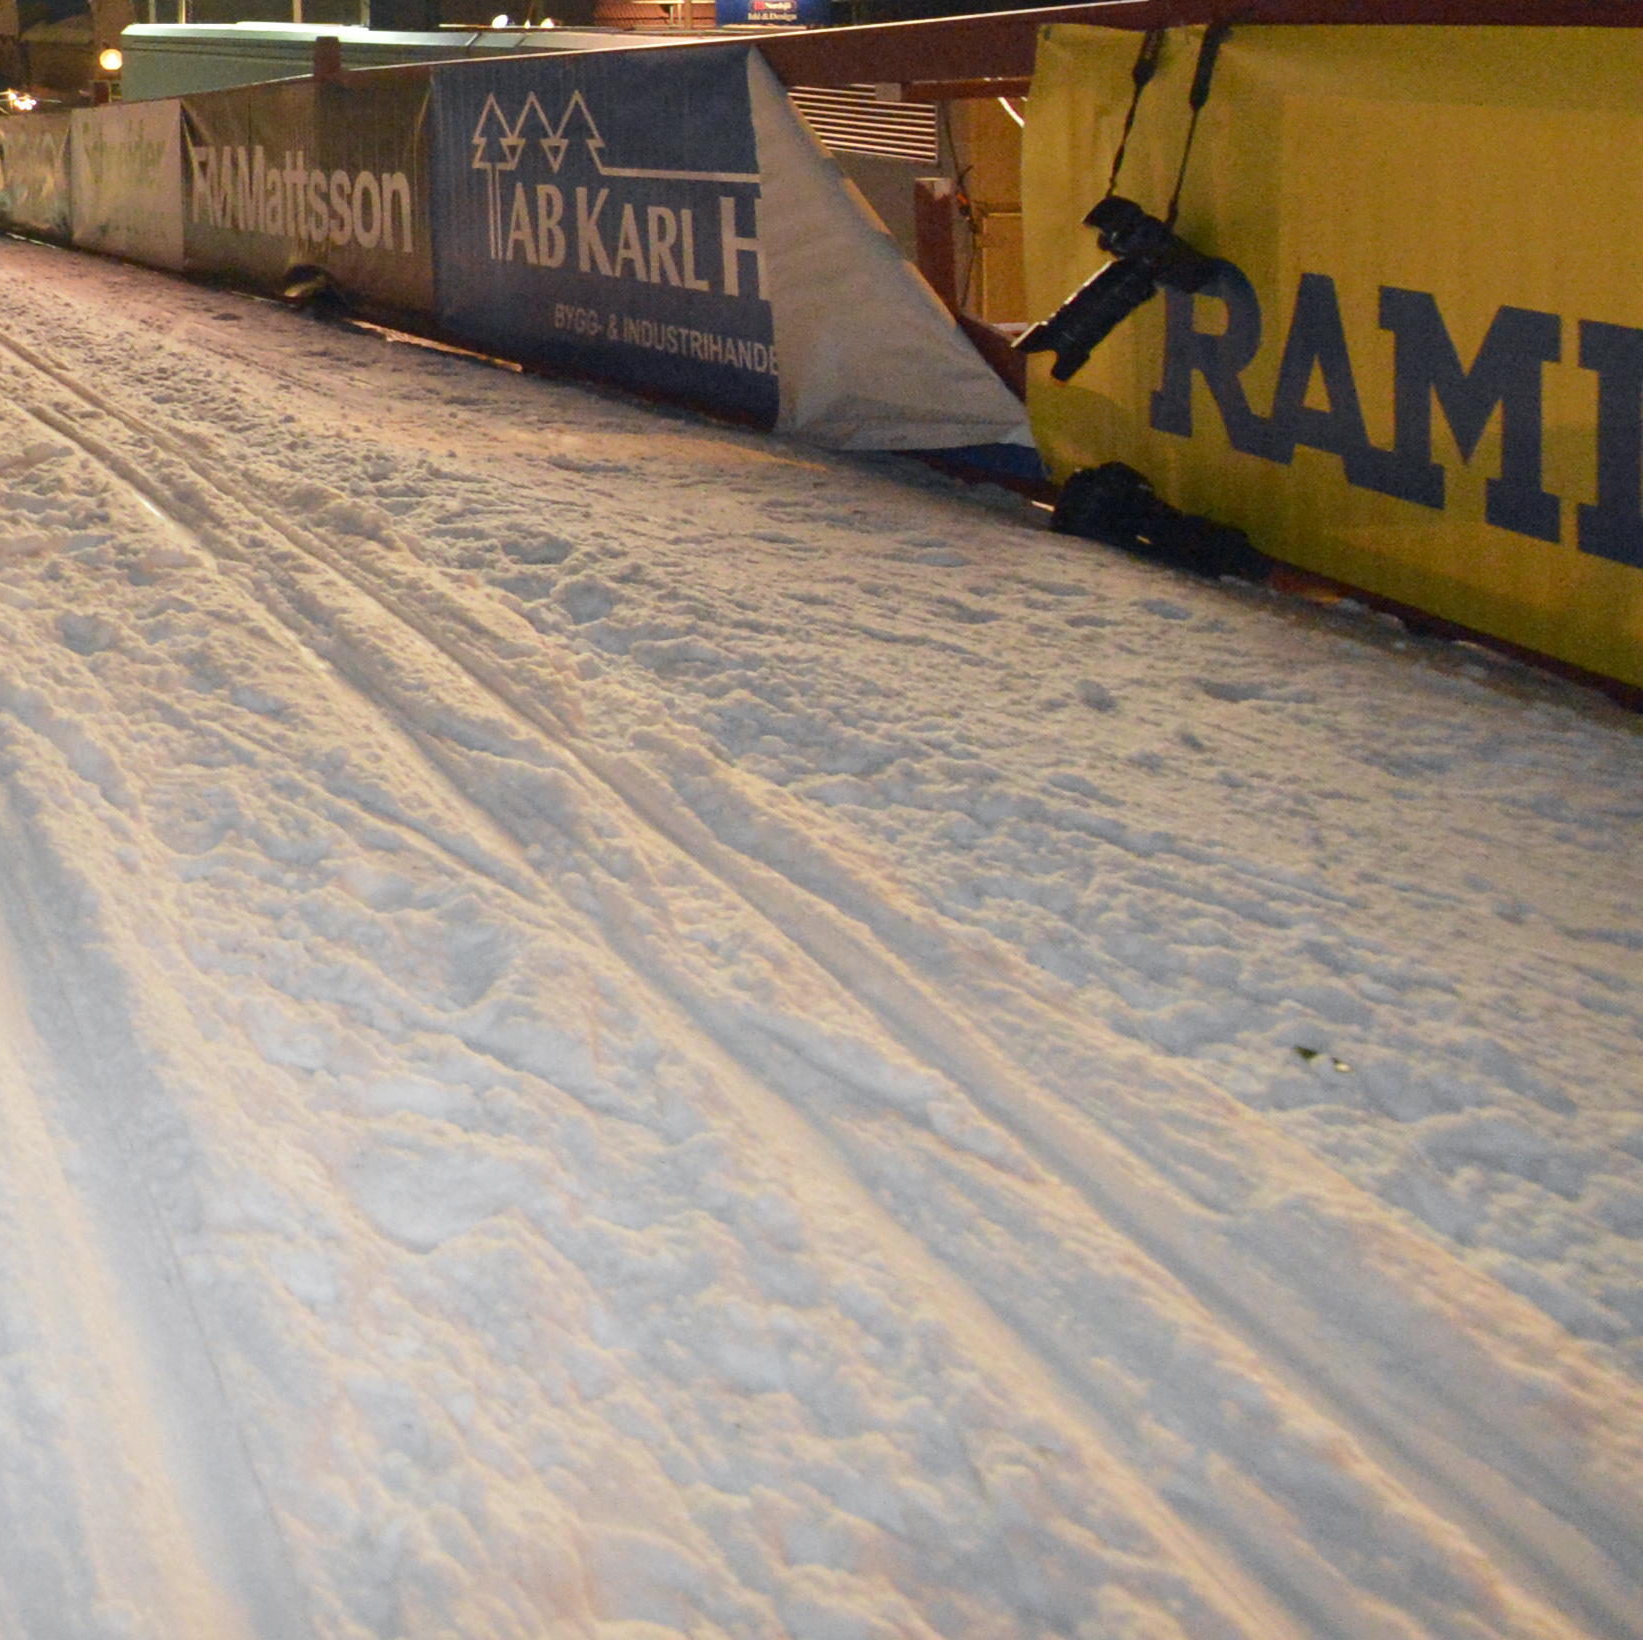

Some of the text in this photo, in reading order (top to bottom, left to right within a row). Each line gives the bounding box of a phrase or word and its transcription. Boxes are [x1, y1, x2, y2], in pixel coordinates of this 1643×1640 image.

[575, 186, 710, 293] KARL
[555, 303, 607, 337] BYGG-
[607, 314, 619, 342] &
